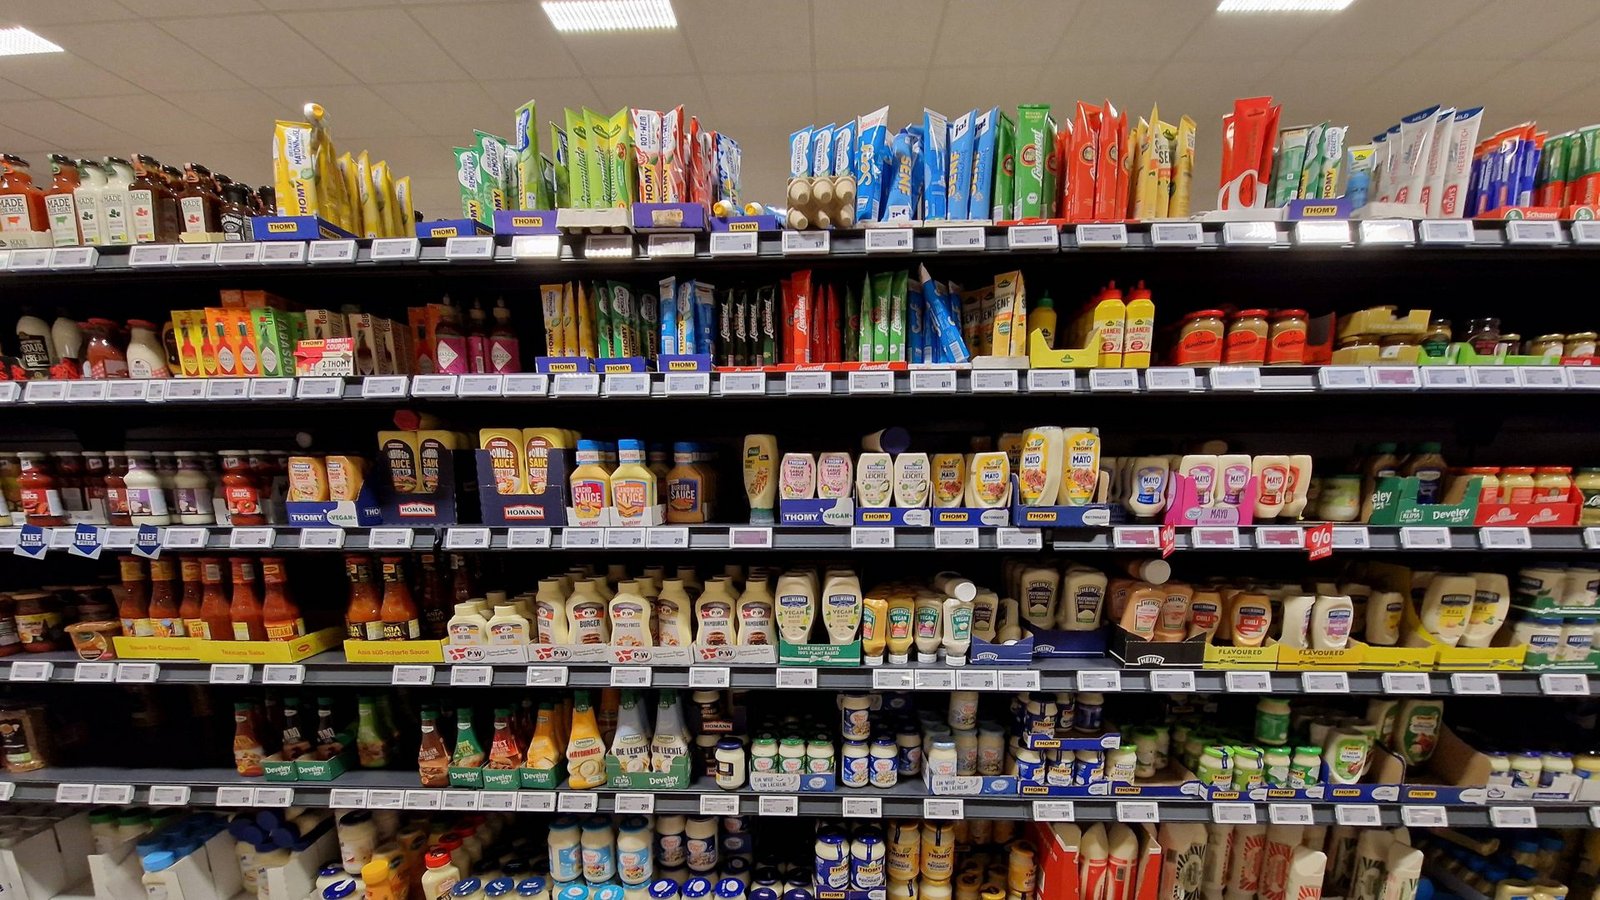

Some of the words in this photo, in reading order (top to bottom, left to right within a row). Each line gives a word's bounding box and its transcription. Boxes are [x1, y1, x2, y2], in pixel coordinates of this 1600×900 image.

[955, 119, 967, 138] ja!
[899, 156, 911, 196] SENF
[949, 152, 960, 196] SENF
[47, 198, 70, 209] MADE
[269, 222, 295, 230] THOMY
[730, 223, 757, 231] THOMY
[994, 298, 1011, 313] SENF
[322, 360, 327, 368] 2
[328, 360, 351, 368] THOMY
[528, 448, 548, 458] POMME
[493, 458, 515, 468] AUCE
[529, 458, 547, 468] SAUC
[1024, 455, 1040, 465] MAYO
[1072, 455, 1092, 464] MAYO
[941, 471, 956, 479] MAYO
[1195, 475, 1210, 484] MAYO
[1230, 475, 1245, 484] MAYO
[1266, 475, 1282, 484] MAYO
[1143, 477, 1159, 485] MAYO
[617, 484, 644, 492] SANDWICH
[575, 492, 601, 503] SAUCE
[617, 491, 644, 502] SAUCE
[671, 489, 696, 500] SAUCE
[401, 505, 433, 513] HOMANN
[785, 513, 819, 521] THOMY
[1210, 509, 1228, 519] MAYO
[1432, 508, 1470, 520] Develey
[22, 533, 42, 541] TIEF
[76, 532, 96, 541] TIEF
[139, 533, 157, 541] TIEF
[579, 620, 601, 628] BURGER
[1140, 656, 1163, 665] HEINZ
[615, 748, 626, 756] DIE
[627, 746, 649, 755] LEICHTE
[652, 747, 660, 755] DIE
[660, 746, 683, 755] LEICHTE
[265, 765, 291, 774] Develey
[298, 765, 324, 774] Develey
[451, 772, 479, 780] Develey
[485, 774, 512, 783] Develey
[649, 776, 679, 785] Develey
